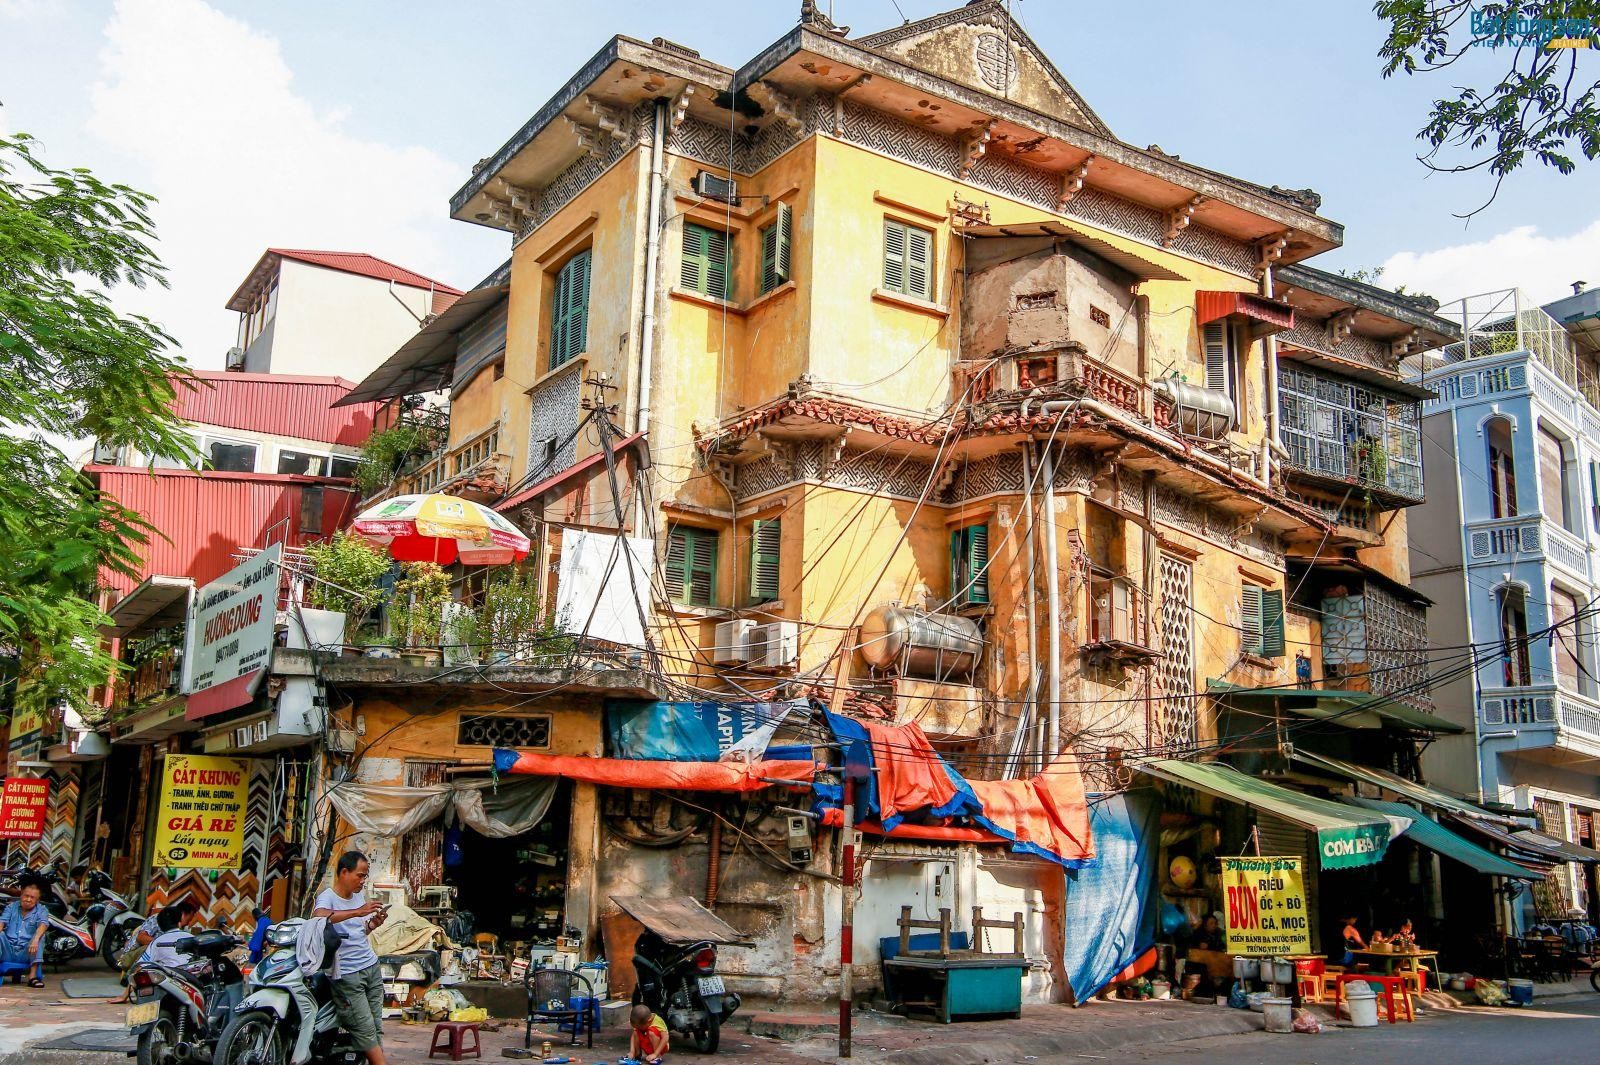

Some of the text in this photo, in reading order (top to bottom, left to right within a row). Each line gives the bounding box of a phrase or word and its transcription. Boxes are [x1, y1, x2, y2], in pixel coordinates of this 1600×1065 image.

[199, 770, 241, 786] KHUNG
[22, 784, 46, 793] KHUNG
[173, 789, 195, 799] TRANH,
[171, 802, 192, 810] TRANH
[194, 801, 209, 811] THÊU
[5, 818, 38, 830] LẤY NGAY
[168, 814, 237, 832] GIÁ RẺ
[170, 833, 229, 847] Lấy ngay
[170, 850, 229, 859] 65 MINH AN
[1324, 838, 1354, 857] CƠM
[1228, 873, 1259, 930] BÚN
[1260, 894, 1273, 910] ỐC
[1286, 894, 1301, 910] BÒ
[1281, 917, 1306, 931] MỌC
